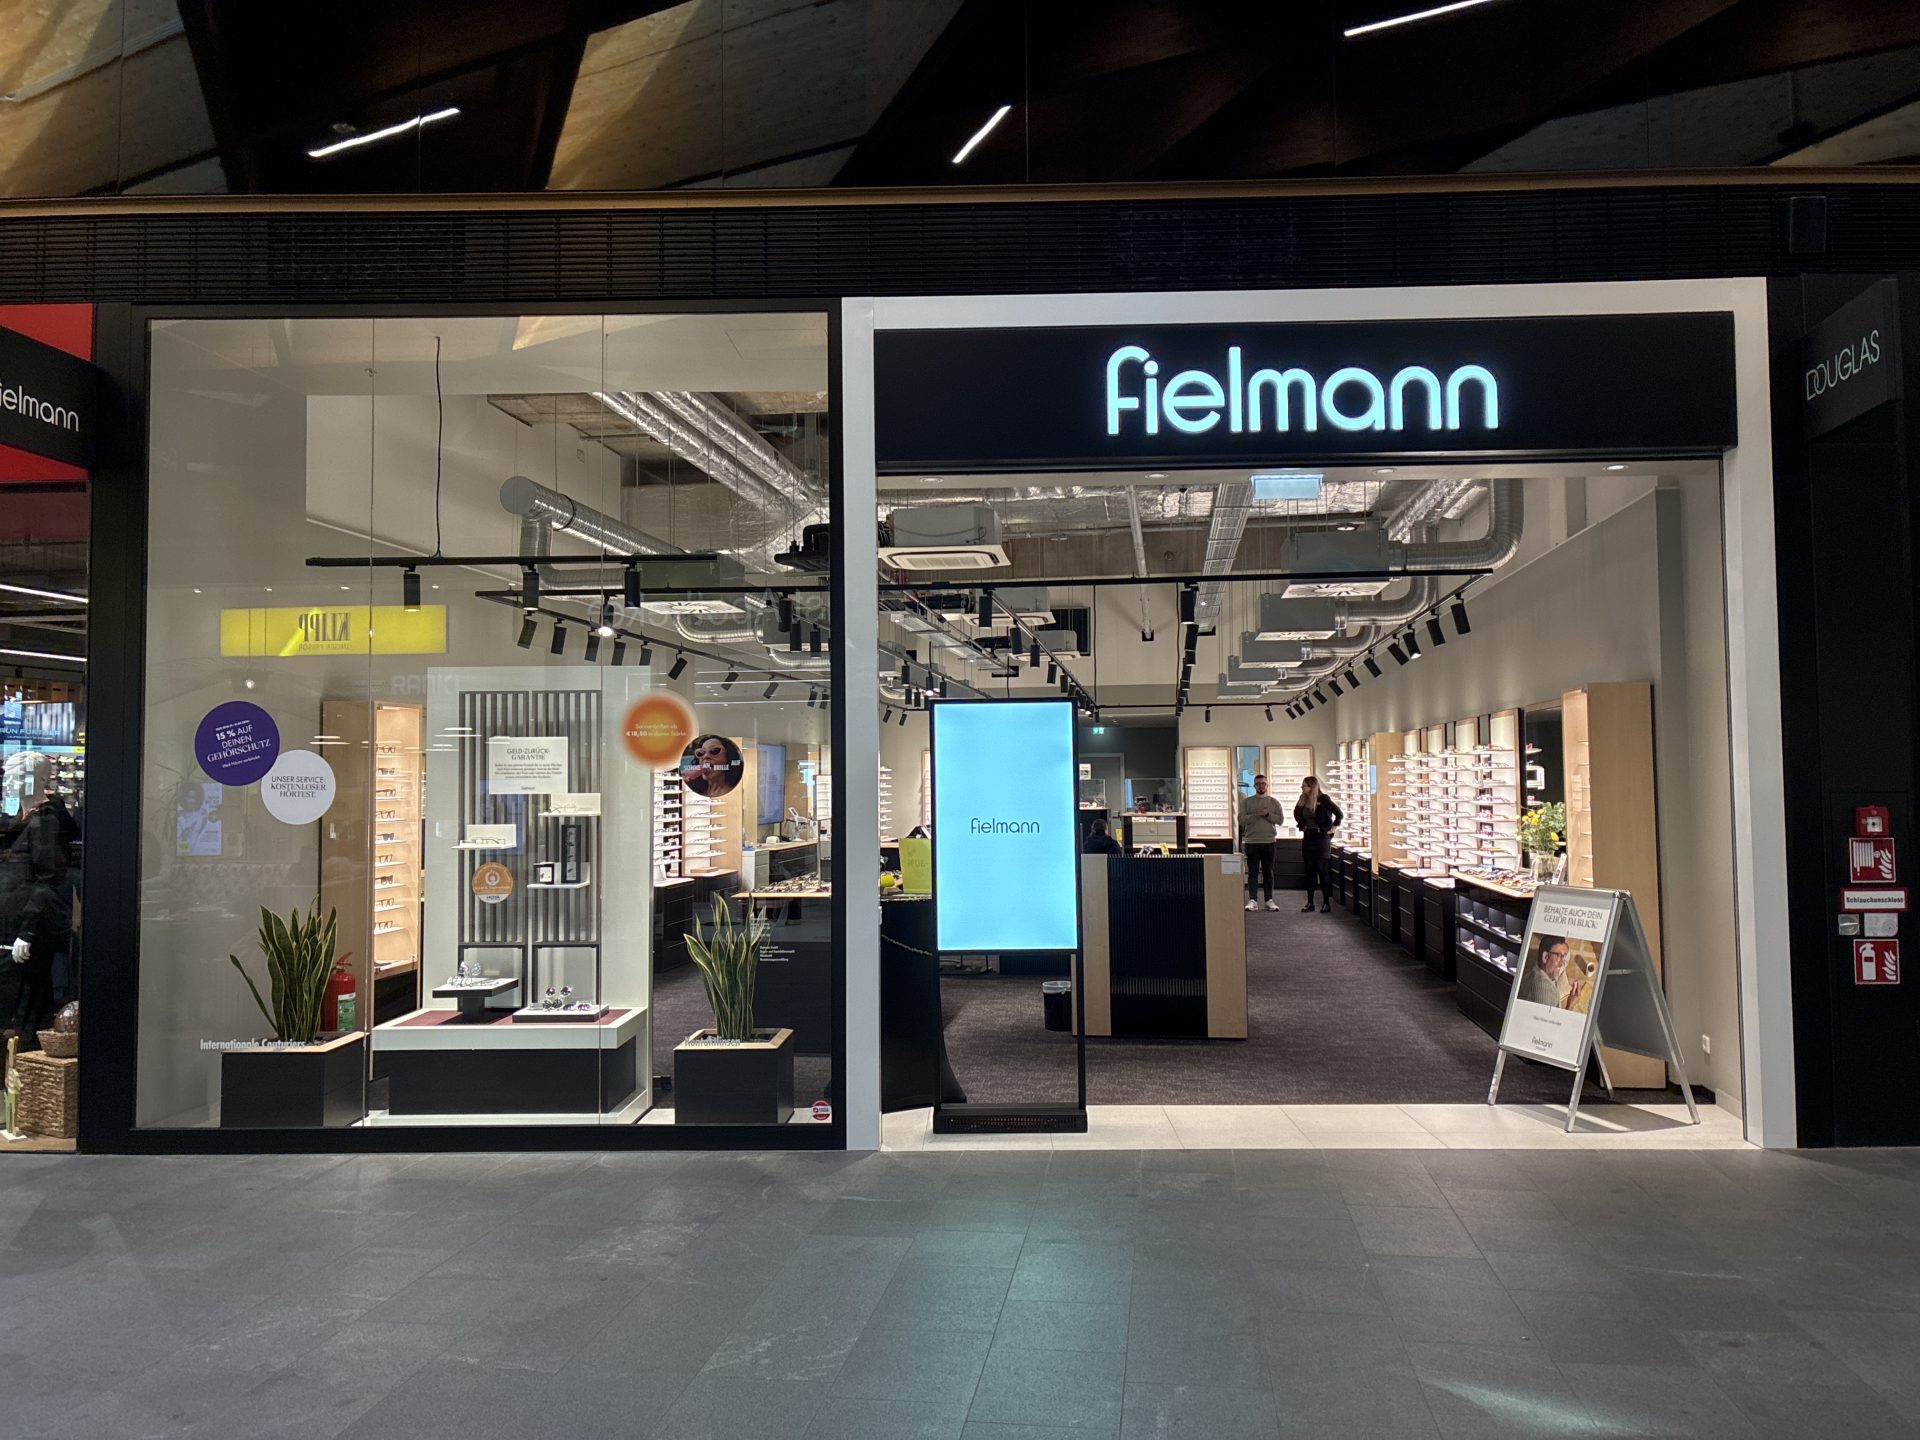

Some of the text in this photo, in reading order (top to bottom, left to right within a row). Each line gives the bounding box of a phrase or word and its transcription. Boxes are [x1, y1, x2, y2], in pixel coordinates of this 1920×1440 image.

[1806, 329, 1880, 401] DOUGLAS
[1106, 345, 1499, 436] fielmann
[0, 382, 79, 432] ielmann
[215, 732, 226, 741] 15
[226, 729, 236, 738] %
[237, 724, 254, 736] AUF
[221, 734, 253, 749] DEINEN
[206, 738, 272, 763] GEHÖRSCHUTZ
[511, 753, 546, 761] GARANTIE
[271, 775, 295, 783] UNSER
[270, 783, 327, 791] KOSTENLOSER
[970, 817, 1040, 834] fielmann
[1543, 905, 1603, 920] BEHALTE AUCH DEIN
[1543, 914, 1568, 925] GEHÖR
[200, 1037, 260, 1050] Internationale
